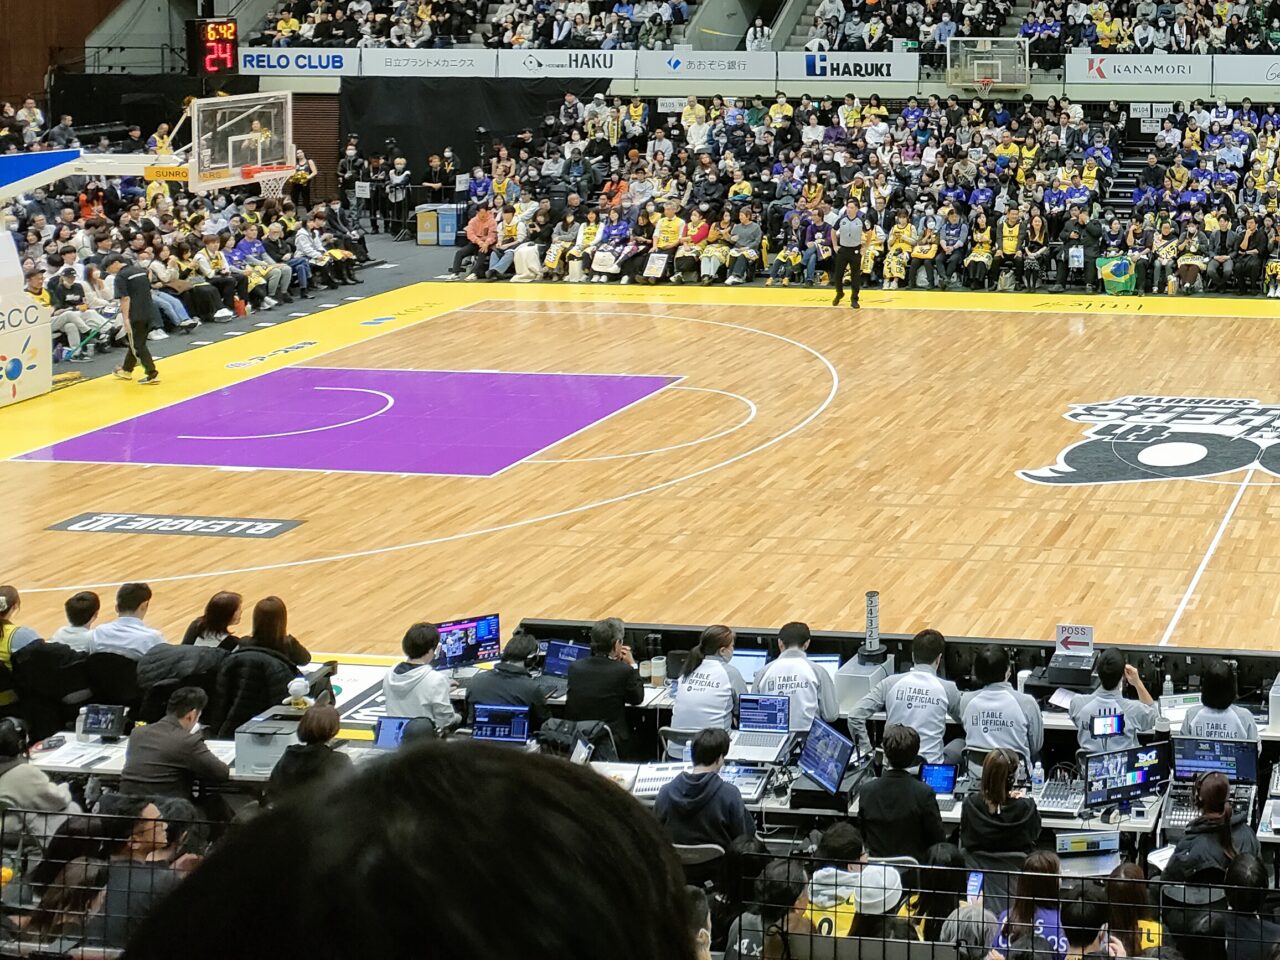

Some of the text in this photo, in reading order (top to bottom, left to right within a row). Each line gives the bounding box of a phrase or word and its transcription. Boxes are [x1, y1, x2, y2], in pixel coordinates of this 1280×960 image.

[207, 23, 235, 40] 6:42
[205, 43, 232, 72] 24
[243, 54, 344, 69] RELO CLUB
[384, 57, 475, 68] 日立プラントメカニクス
[568, 53, 614, 69] HAKU
[686, 60, 747, 71] あおぞら銀行
[830, 62, 892, 77] HARUKI
[1113, 65, 1192, 74] KANAMORI
[1131, 397, 1256, 406] SHIBUYA
[117, 517, 282, 535] B.LEAGUE
[691, 672, 711, 680] TABLE
[688, 679, 721, 689] OFFICIALS
[777, 681, 809, 690] OFFICIALS
[908, 687, 930, 696] TABLE
[907, 695, 941, 706] OFFICIALS
[981, 711, 1003, 719] TABLE
[981, 719, 1014, 728] OFFICIALS
[1205, 722, 1227, 731] TABLE
[1205, 730, 1238, 738] OFFICIALS
